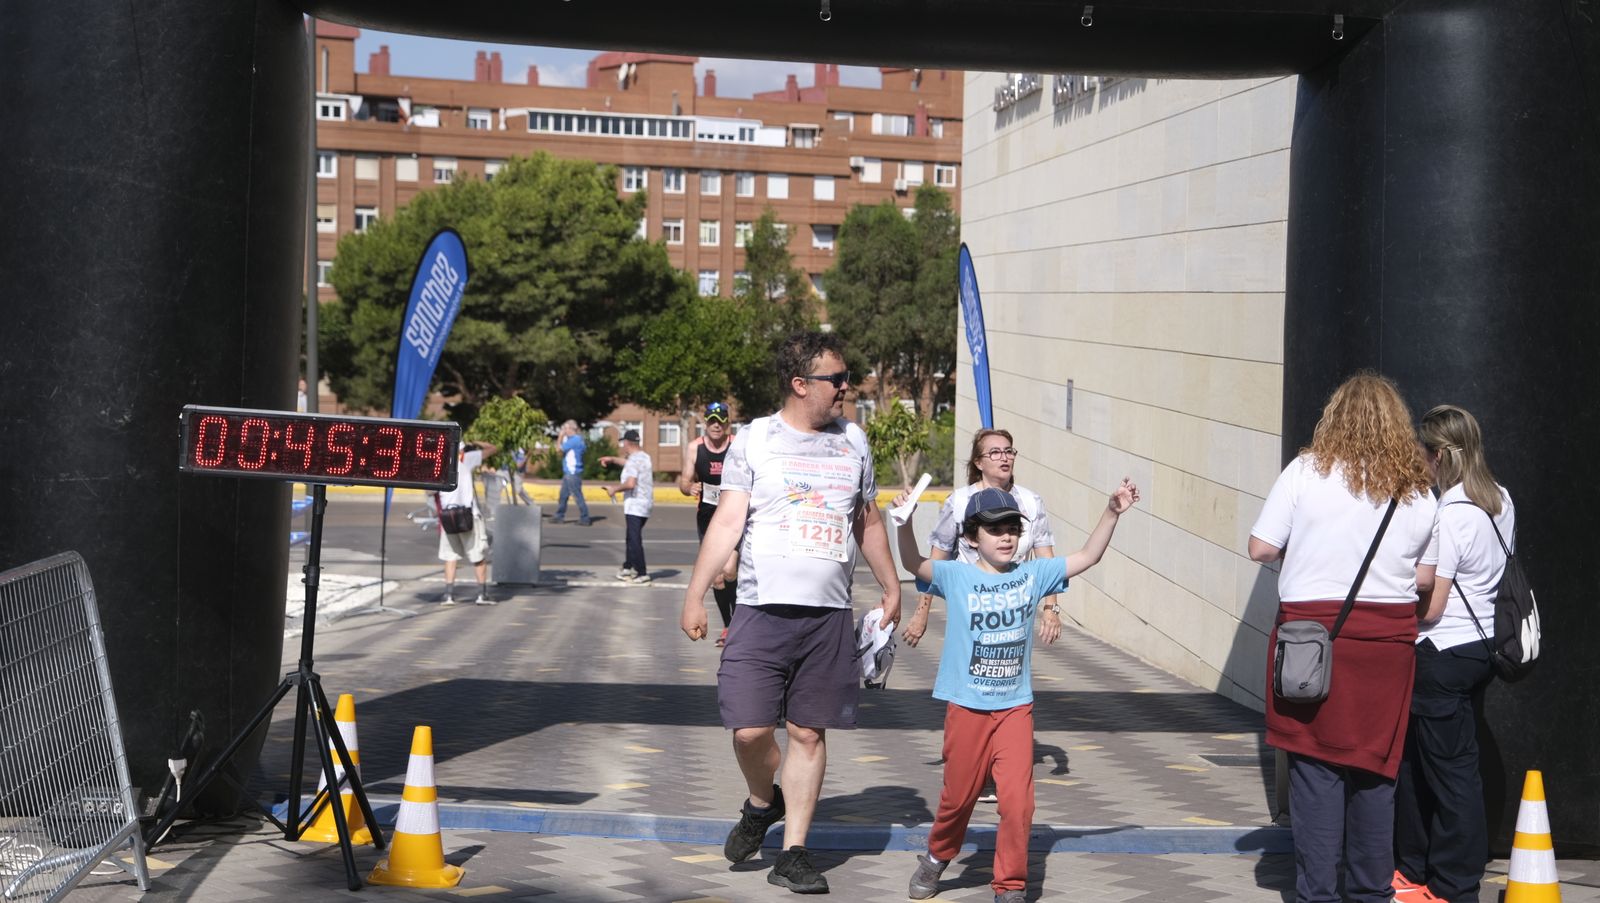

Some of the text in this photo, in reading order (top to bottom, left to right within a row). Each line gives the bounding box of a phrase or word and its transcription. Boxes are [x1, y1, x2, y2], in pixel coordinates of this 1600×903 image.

[196, 416, 446, 478] 00:45:34
[799, 524, 843, 545] 1212
[970, 596, 1034, 631] ROUTE
[974, 644, 1025, 659] EIGHTYFIVE
[973, 678, 1017, 687] OVERDRIVE
